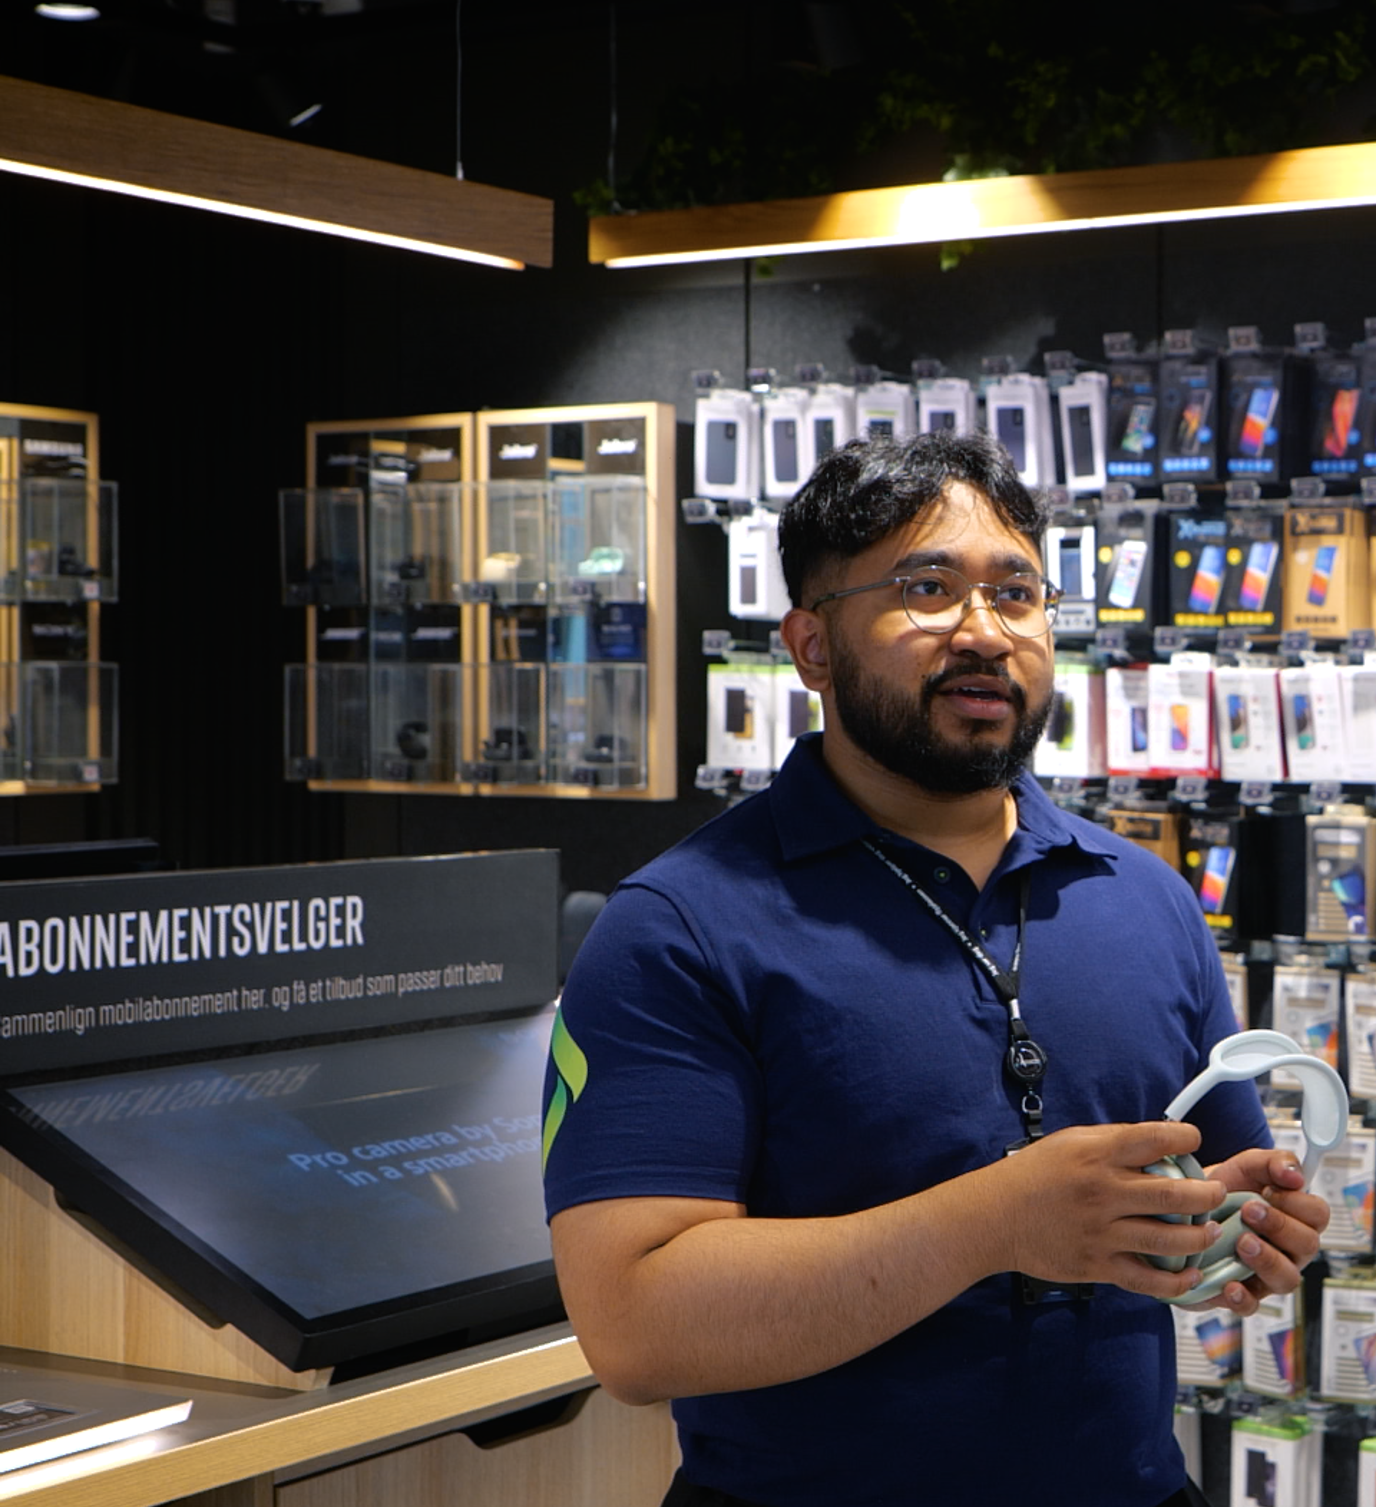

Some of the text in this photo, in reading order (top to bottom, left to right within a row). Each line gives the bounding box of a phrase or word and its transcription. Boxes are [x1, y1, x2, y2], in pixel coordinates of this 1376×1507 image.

[0, 895, 365, 978] ABONNEMENTSVELGER
[0, 1005, 95, 1038] ammenlign
[100, 988, 239, 1027] mobilabonnement
[271, 986, 290, 1012] og
[293, 979, 306, 1005] få
[309, 981, 323, 1003] et
[325, 974, 363, 1000] tilbud
[366, 976, 396, 998] som
[398, 968, 441, 998] passer
[443, 963, 465, 989] ditt
[466, 960, 504, 986] behov
[287, 1148, 349, 1172] Pro
[352, 1130, 458, 1161] camera
[452, 1124, 498, 1142] by
[336, 1168, 379, 1187] in
[378, 1164, 404, 1181] a
